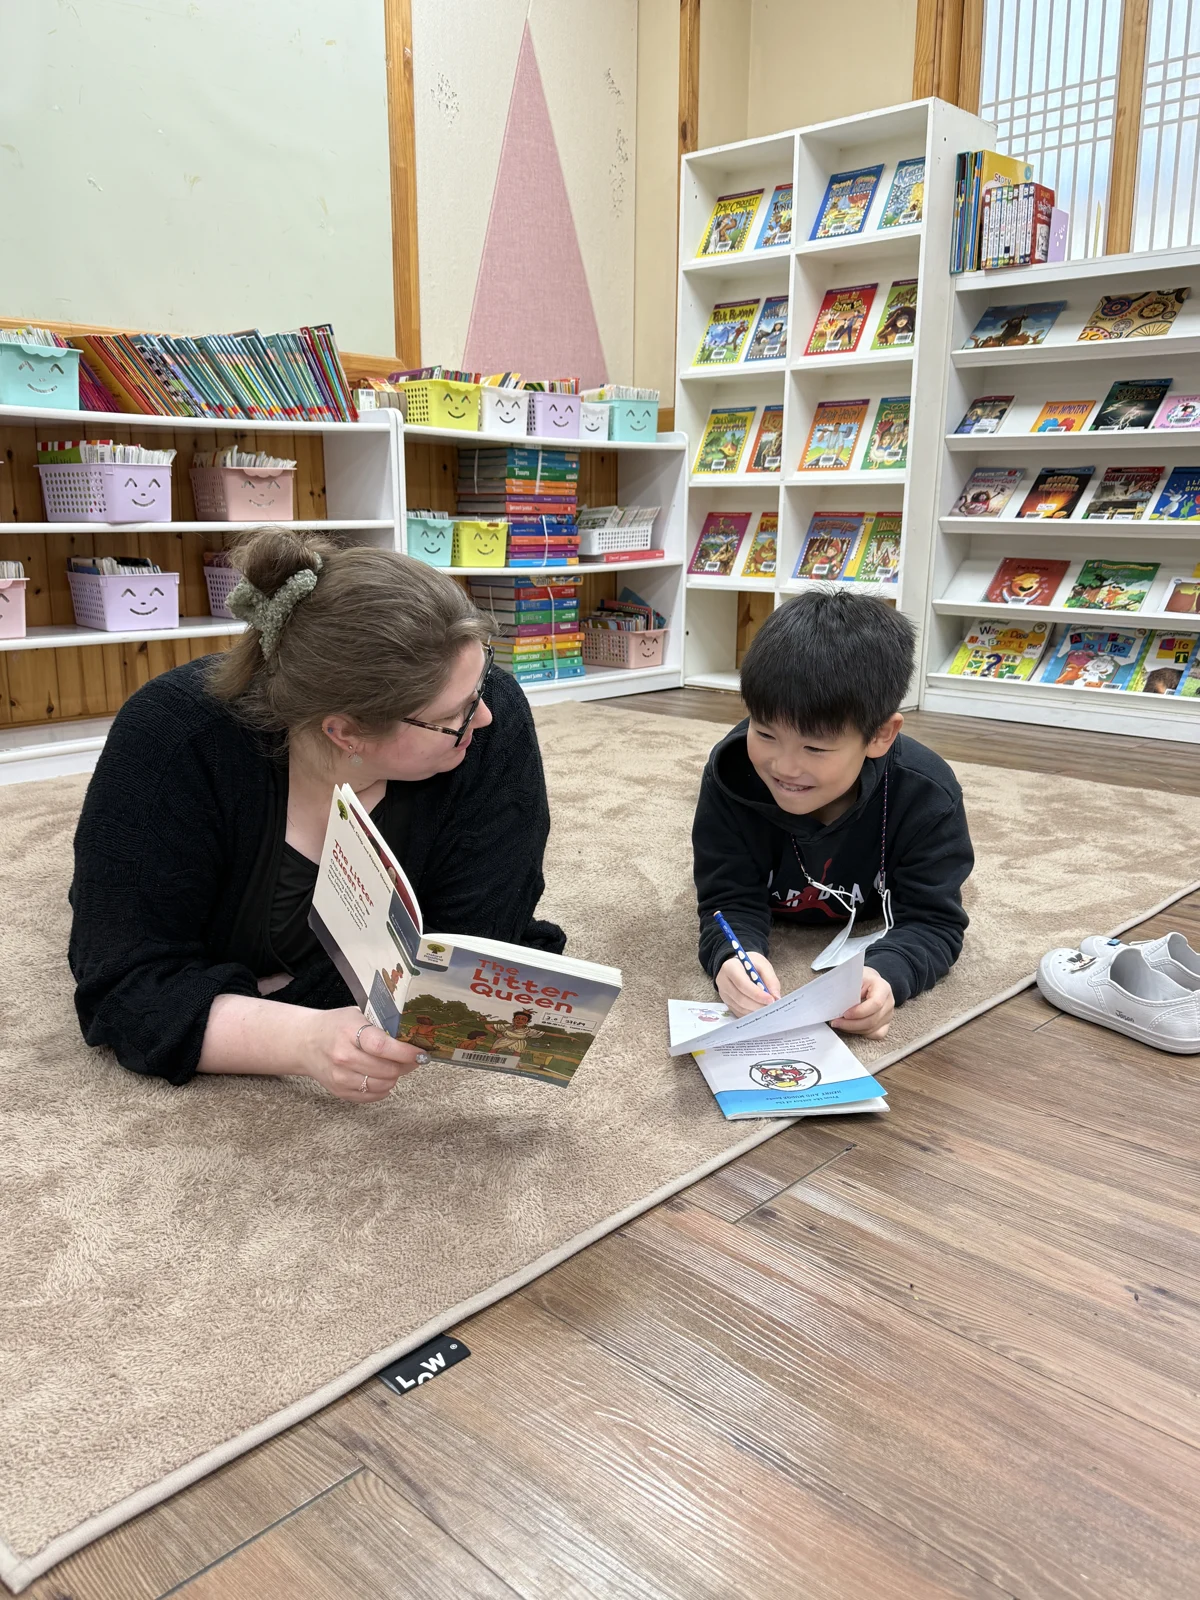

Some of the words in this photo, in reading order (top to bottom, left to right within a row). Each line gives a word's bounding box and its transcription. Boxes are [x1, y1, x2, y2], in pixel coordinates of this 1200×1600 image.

[994, 173, 1012, 185] Story
[980, 626, 1008, 638] Where
[1097, 643, 1126, 654] Live
[1161, 639, 1189, 651] Life
[332, 849, 357, 892] Queen
[334, 839, 349, 866] The
[350, 865, 375, 908] Litter
[478, 959, 520, 976] The
[472, 969, 579, 1000] Litter
[470, 982, 573, 1014] Queen
